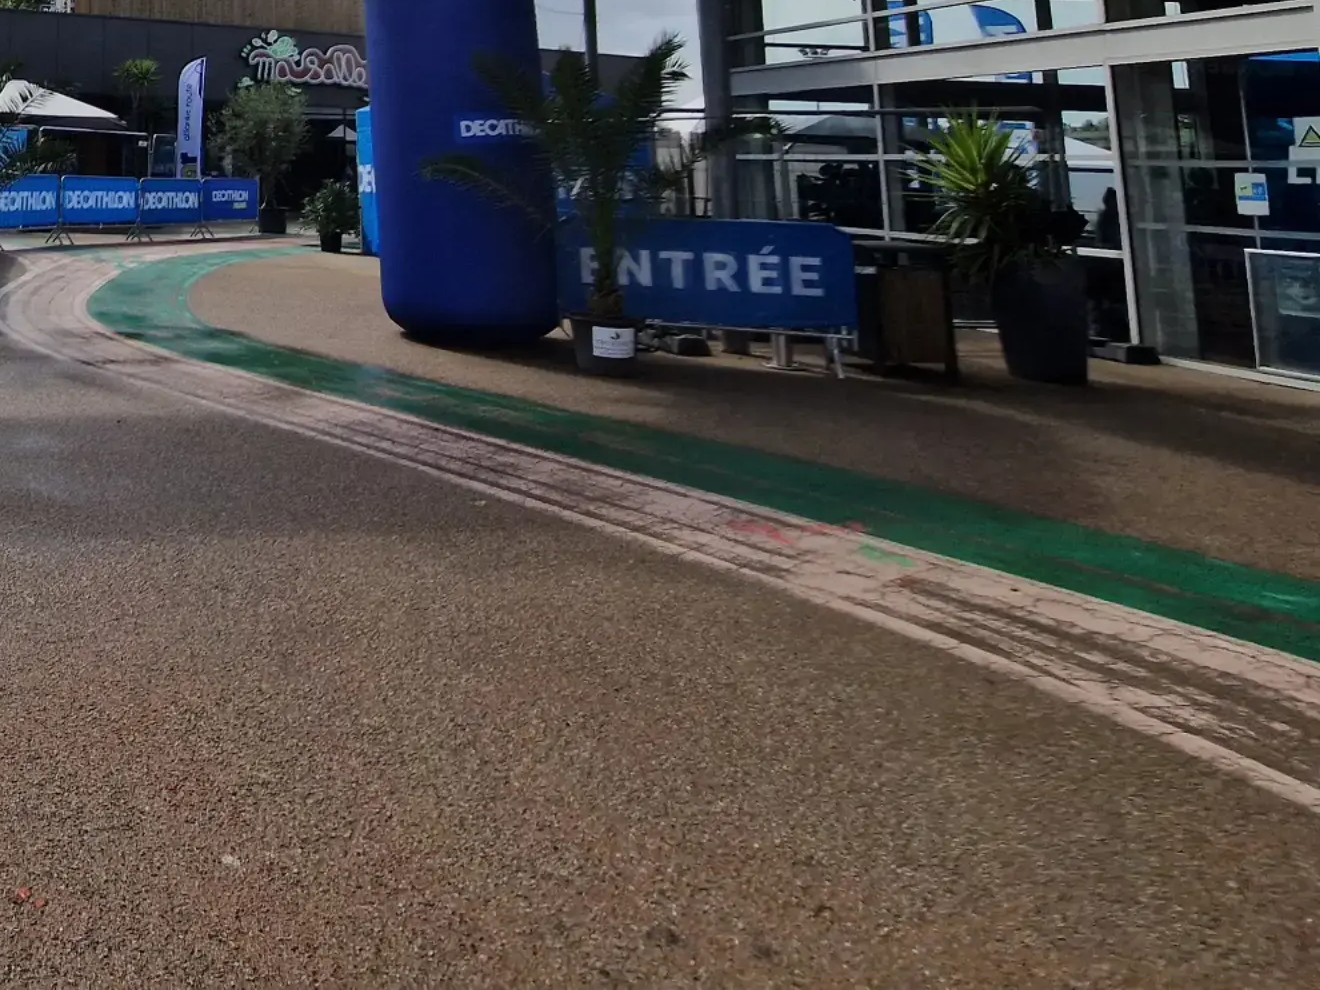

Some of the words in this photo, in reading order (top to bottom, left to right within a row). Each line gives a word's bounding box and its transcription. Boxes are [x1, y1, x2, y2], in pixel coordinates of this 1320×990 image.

[66, 190, 135, 209] DECATHLON
[144, 191, 199, 210] DECATHLON
[212, 190, 249, 202] DECATHLON
